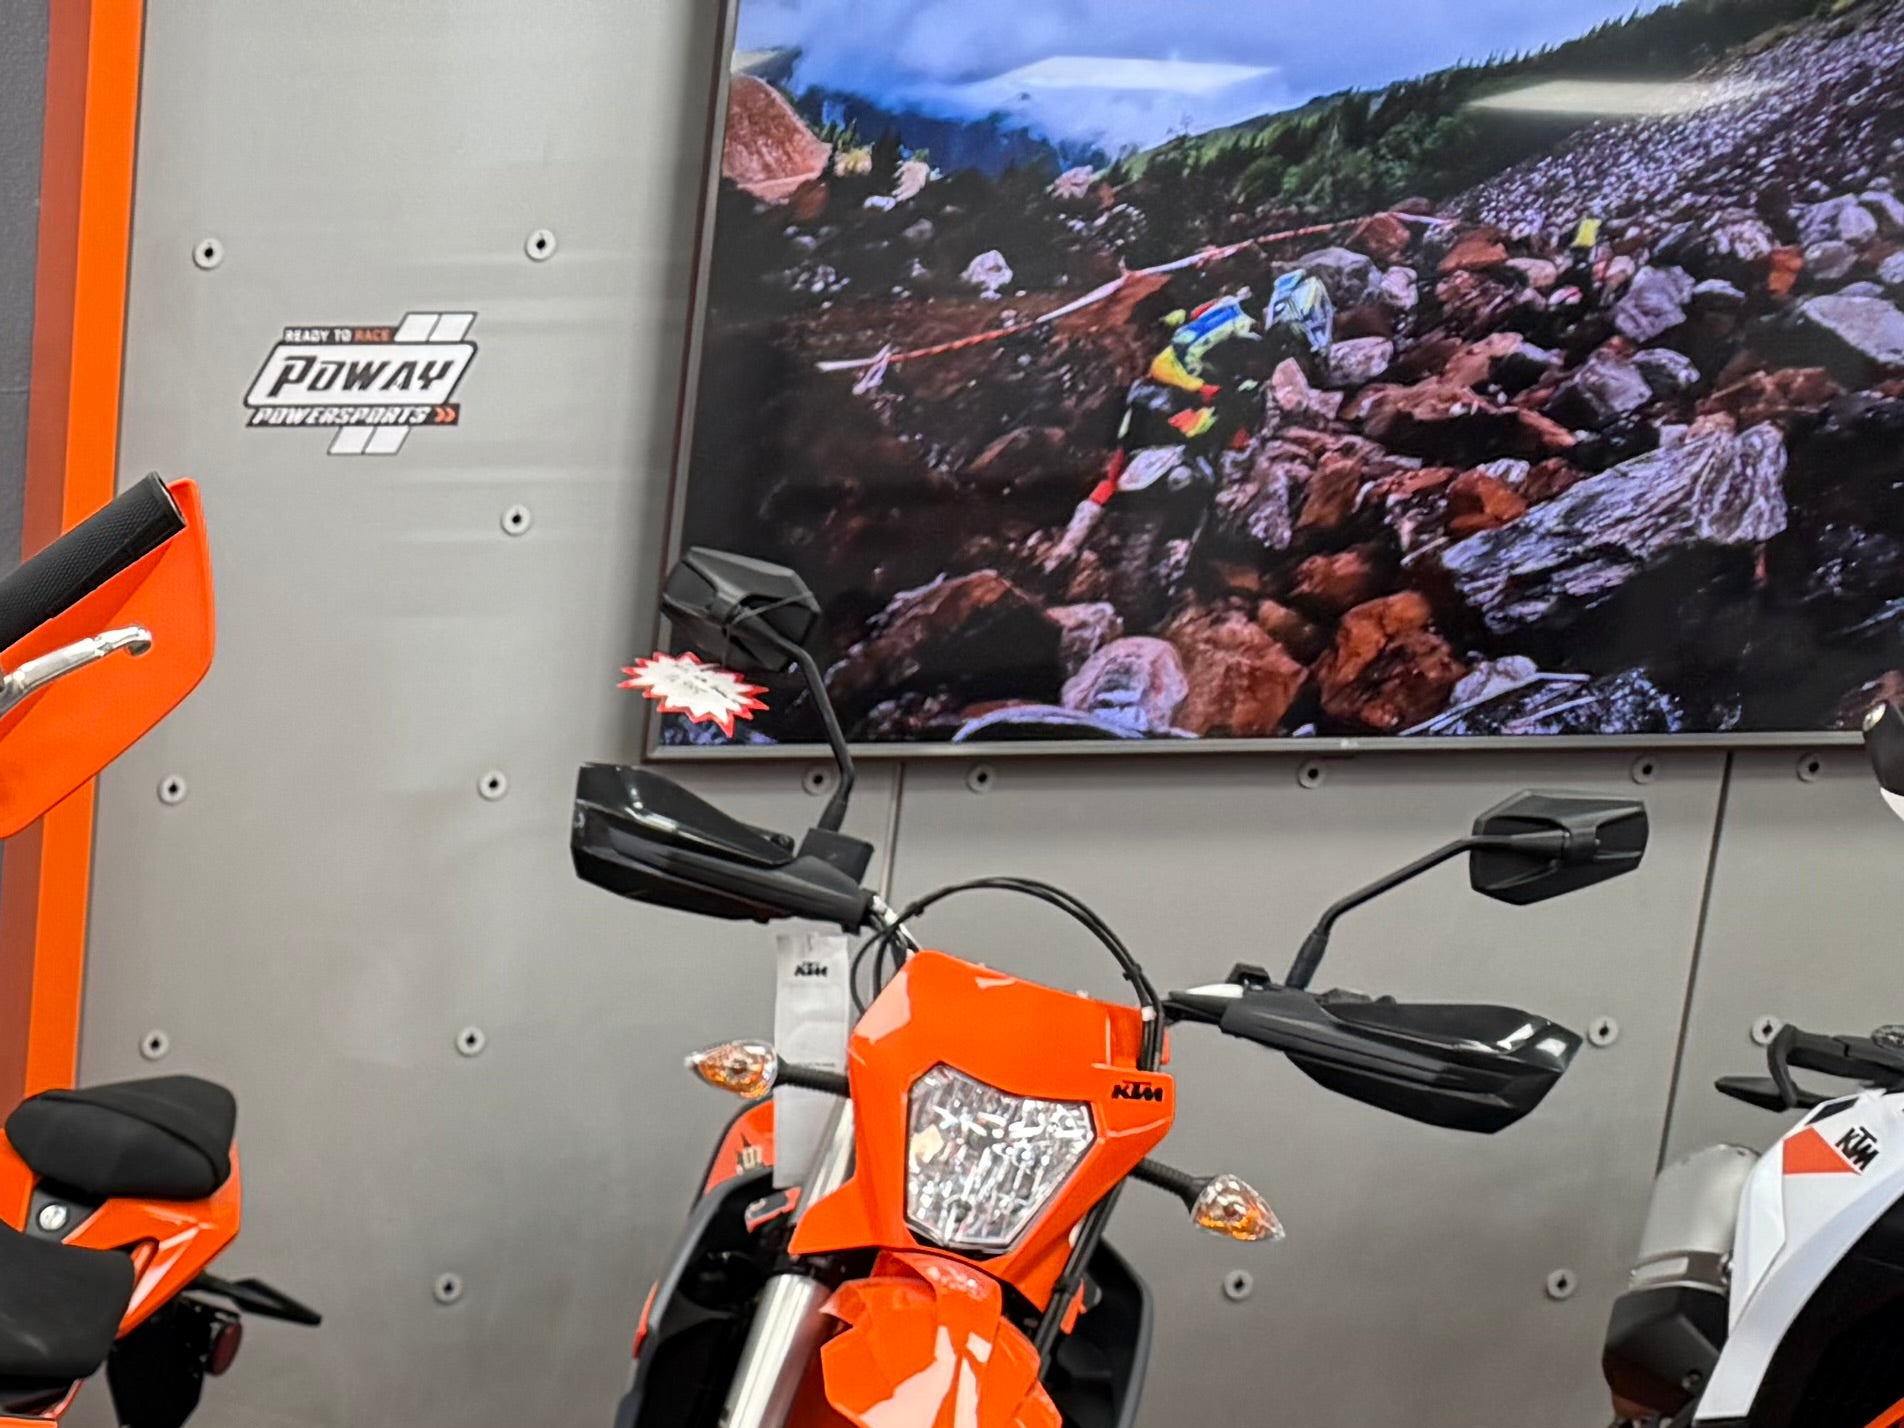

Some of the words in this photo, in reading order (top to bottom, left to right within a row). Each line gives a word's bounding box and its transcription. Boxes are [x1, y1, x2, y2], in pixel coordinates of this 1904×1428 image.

[284, 328, 330, 343] READY
[333, 328, 352, 343] TO
[266, 355, 455, 398] POWAY
[252, 406, 431, 425] POWERSPORTS
[1111, 1080, 1163, 1102] KTM
[1835, 1125, 1880, 1171] KTM
